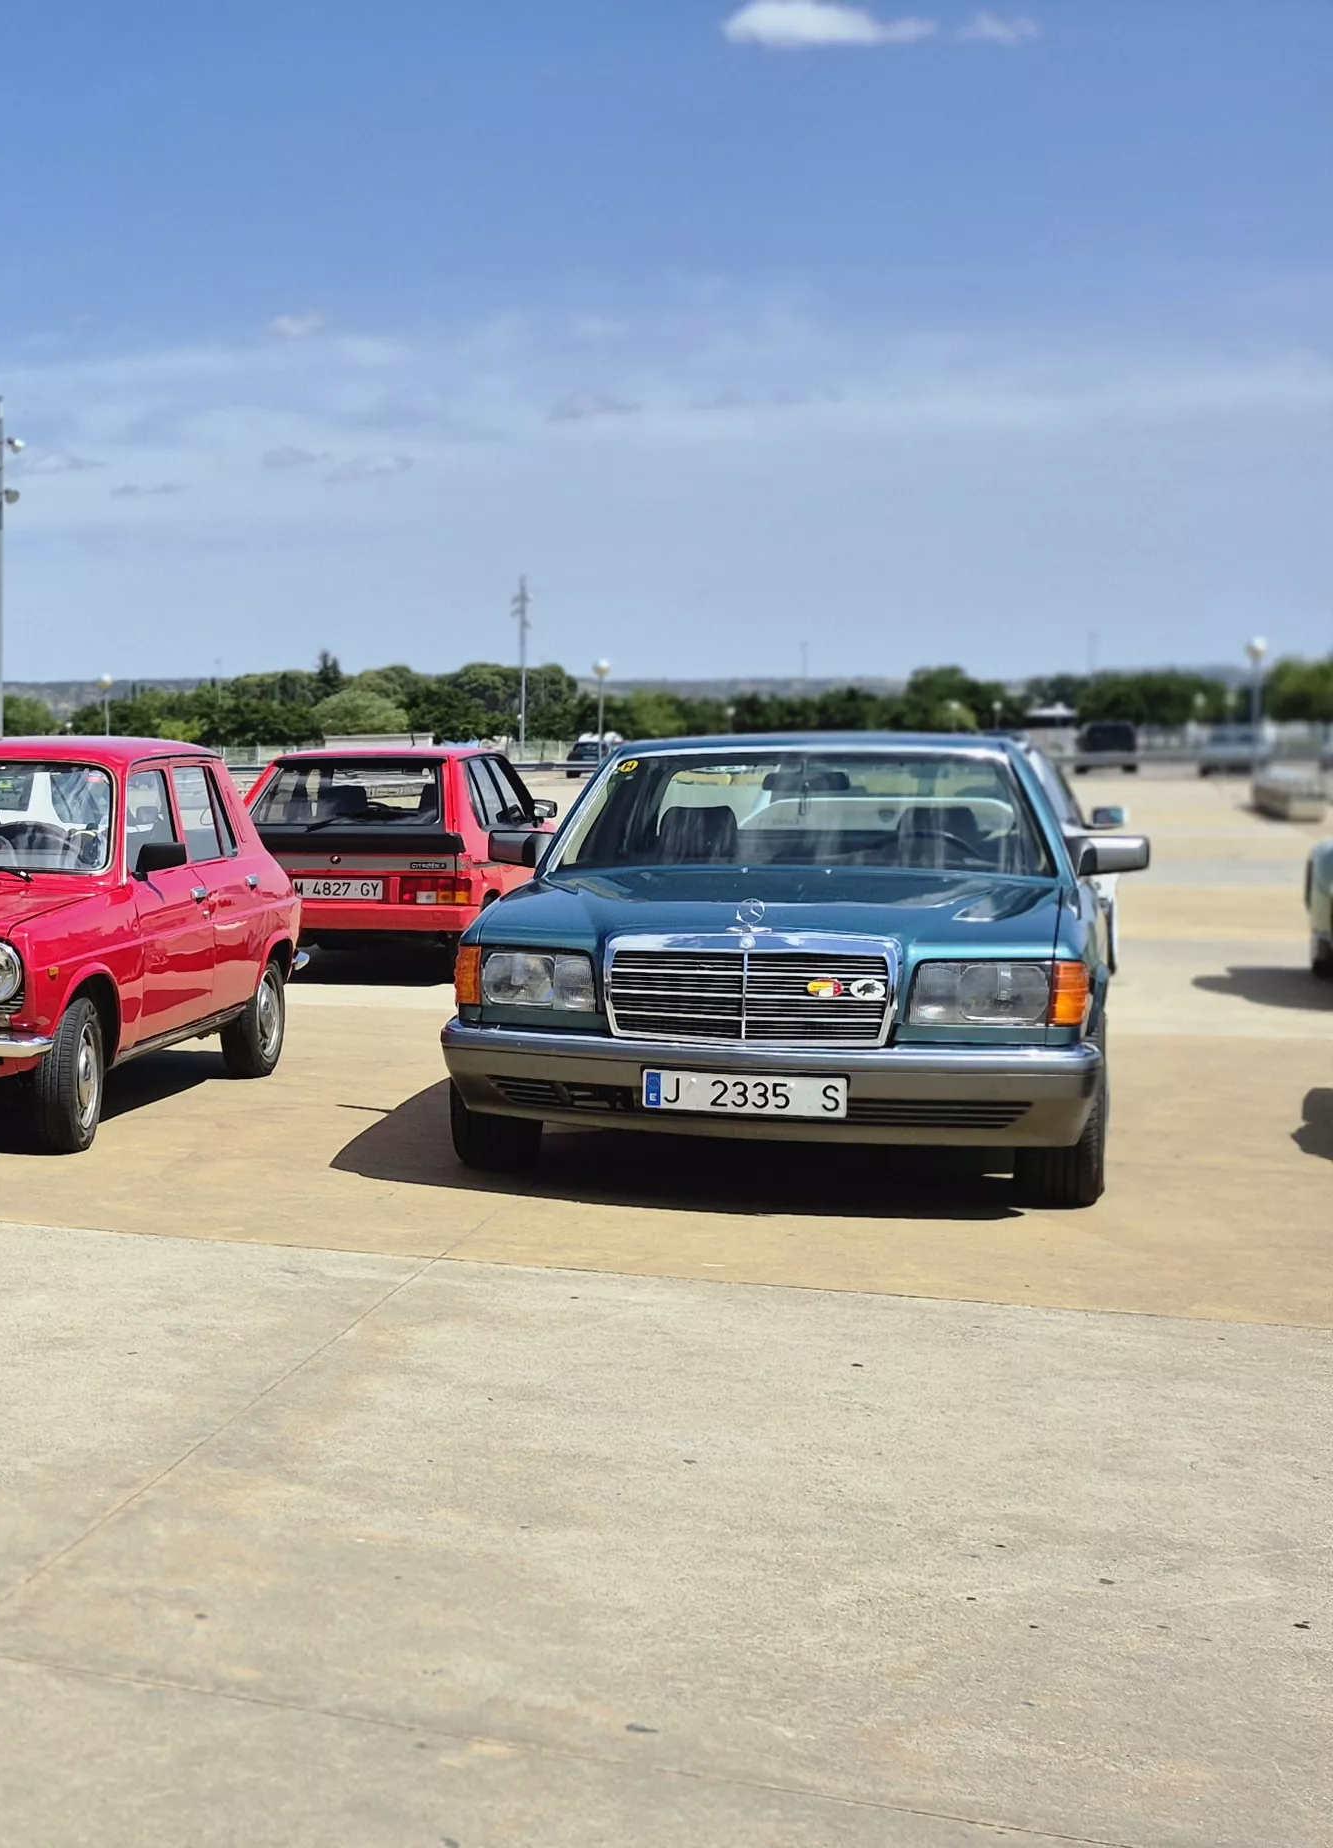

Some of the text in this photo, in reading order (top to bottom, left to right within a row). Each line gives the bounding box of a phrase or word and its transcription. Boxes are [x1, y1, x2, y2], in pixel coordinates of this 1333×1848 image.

[294, 881, 381, 897] M 4827 GY
[663, 1078, 840, 1112] J 2335 S
